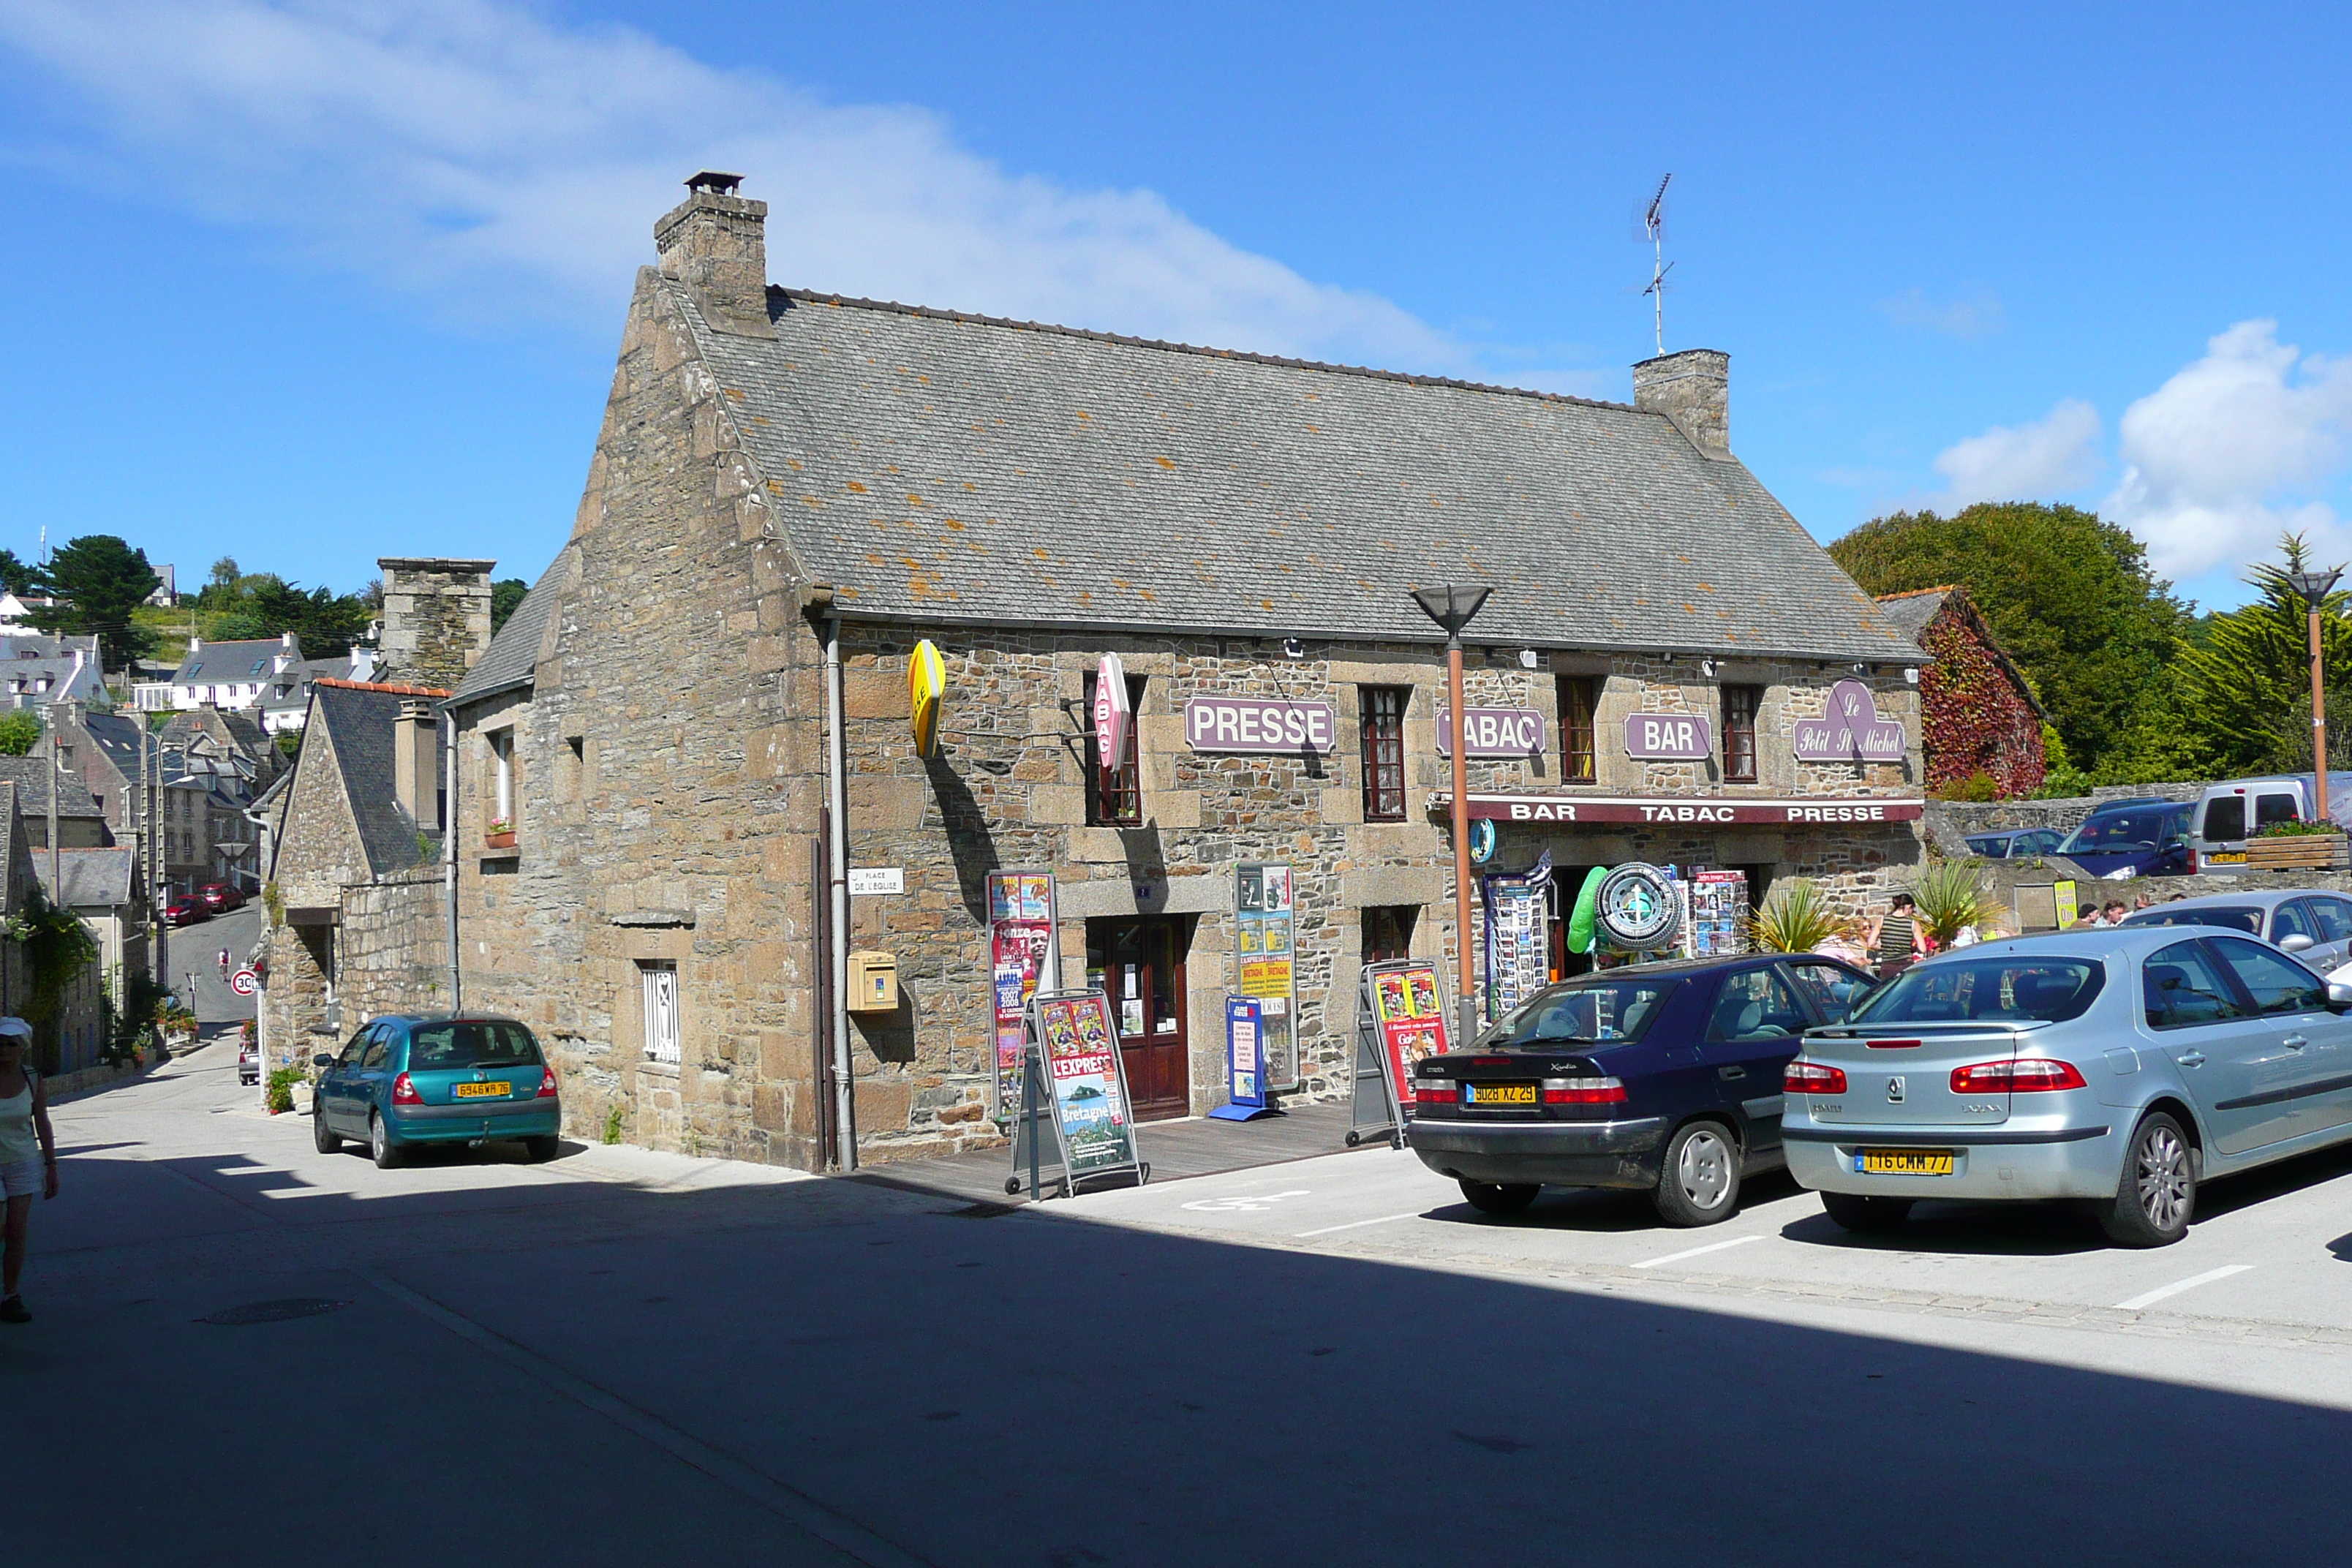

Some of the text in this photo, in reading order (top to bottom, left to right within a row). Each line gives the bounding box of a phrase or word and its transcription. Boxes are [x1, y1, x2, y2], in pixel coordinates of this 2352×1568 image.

[1097, 672, 1110, 754] TABAC
[1844, 693, 1860, 717] Le
[1194, 705, 1328, 745] PRESSE
[1644, 720, 1694, 751] BAR
[1800, 727, 1831, 753] Petit
[1858, 729, 1901, 753] Michel
[1510, 804, 1885, 822] BAR TABAC PRESSE
[854, 881, 897, 891] DE L'ÉGLISE
[1000, 991, 1019, 1000] 2007
[1001, 998, 1019, 1008] 2008
[1550, 1063, 1578, 1072] Xantia
[460, 1085, 483, 1095] 6946
[498, 1083, 509, 1093] 76
[1476, 1088, 1499, 1101] 9028
[1503, 1088, 1516, 1101] XZ
[1520, 1087, 1533, 1101] 29
[1062, 1106, 1109, 1123] Bretagne
[1866, 1153, 1893, 1169] 116
[1896, 1153, 1926, 1170] CMM
[1930, 1153, 1949, 1170] 77
